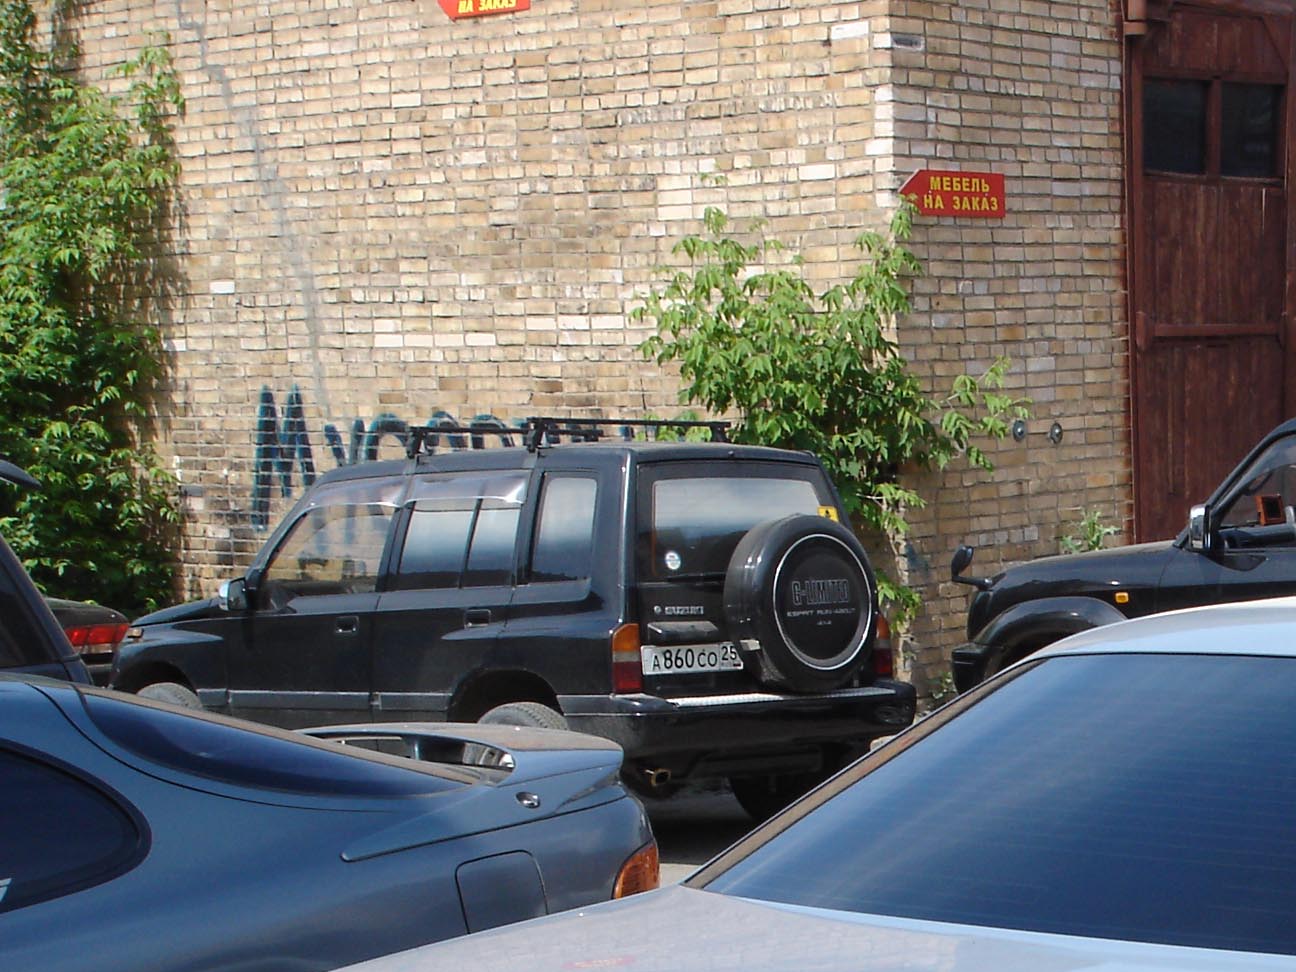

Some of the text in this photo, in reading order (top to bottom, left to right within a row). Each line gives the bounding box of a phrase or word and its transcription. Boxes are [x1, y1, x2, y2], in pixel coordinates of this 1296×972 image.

[929, 176, 990, 193] МЕБЕЛЬ
[923, 195, 999, 211] НА ЗАКАЗ
